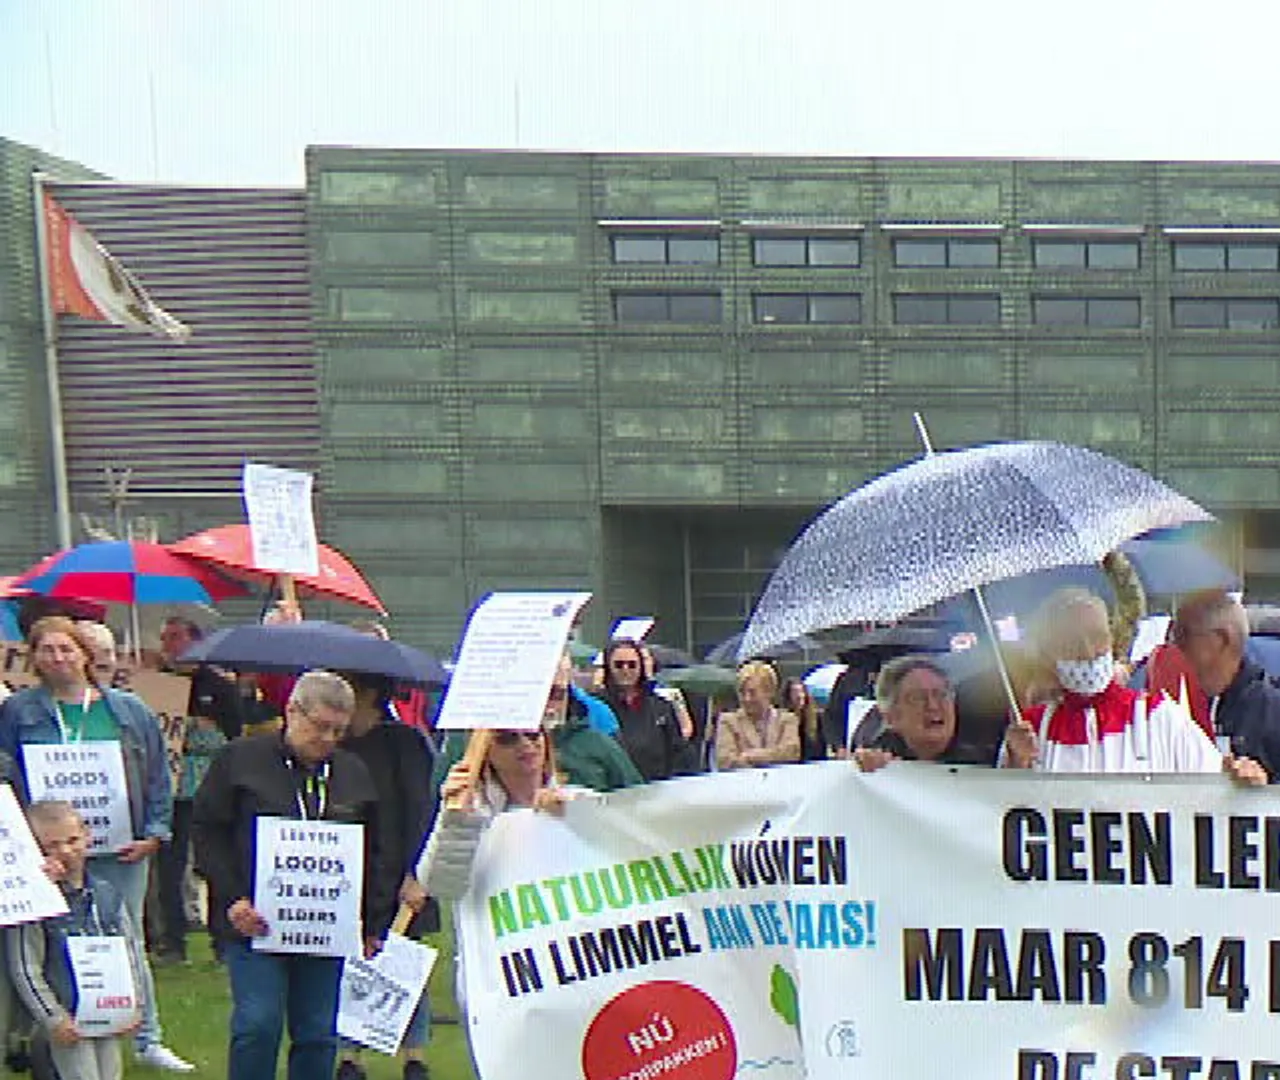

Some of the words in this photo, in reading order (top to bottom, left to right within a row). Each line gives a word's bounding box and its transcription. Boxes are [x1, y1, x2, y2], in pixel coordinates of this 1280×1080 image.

[274, 855, 345, 874] LOODS
[1001, 807, 1173, 886] GEEN
[278, 908, 337, 925] ELDERS
[488, 842, 732, 938] NATUURLIJK
[500, 946, 544, 998] IN
[548, 911, 702, 986] LIMMEL
[786, 899, 878, 950] AAS!
[902, 927, 1107, 1005] MAAR
[1126, 931, 1250, 1012] 814
